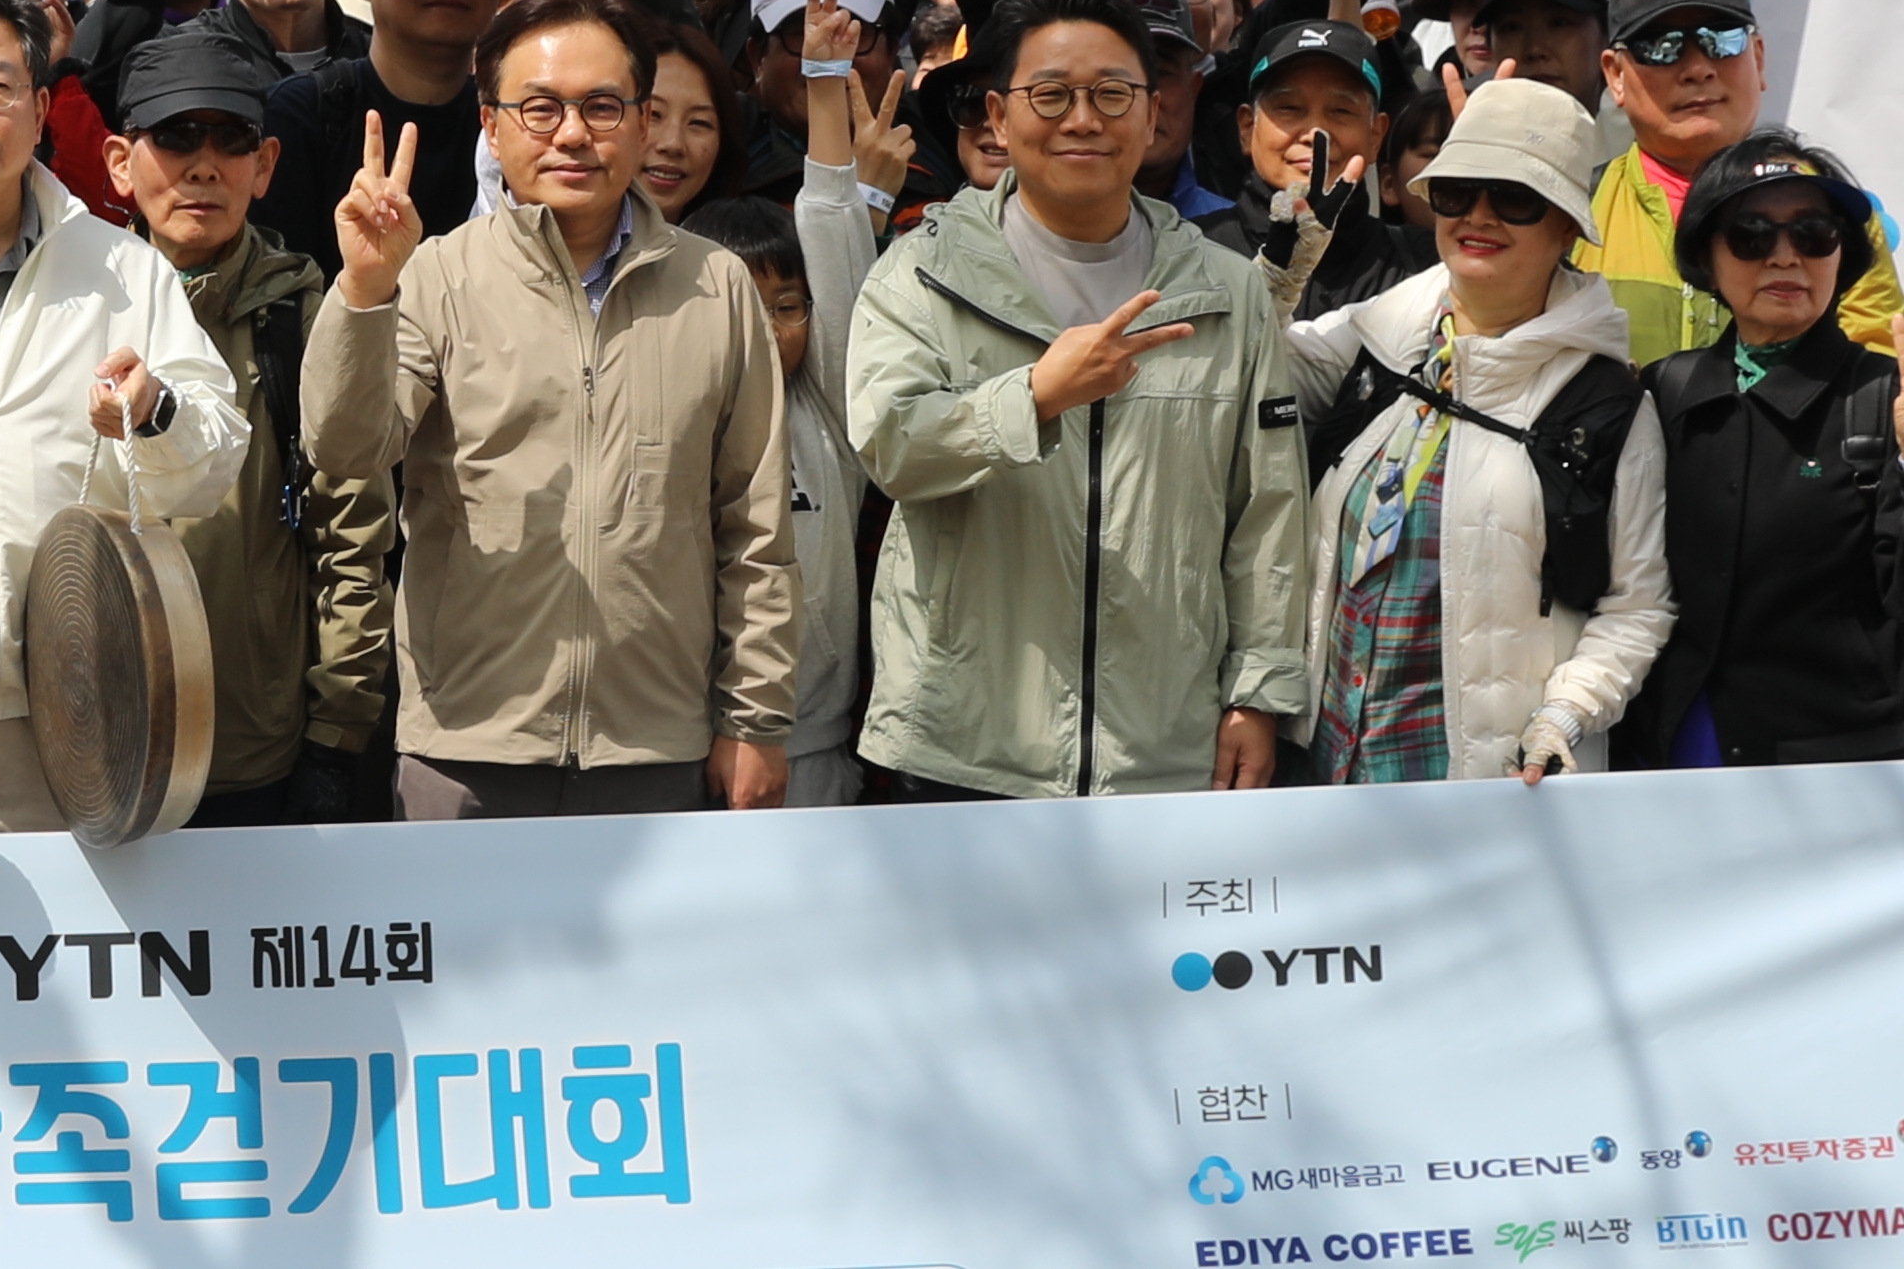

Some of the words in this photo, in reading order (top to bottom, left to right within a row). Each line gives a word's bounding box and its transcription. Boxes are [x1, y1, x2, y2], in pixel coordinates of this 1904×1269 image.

[1186, 878, 1253, 917] 주최
[250, 922, 434, 989] 제14회
[1262, 944, 1383, 987] YTN
[1198, 1084, 1268, 1123] 협찬
[1426, 1154, 1591, 1181] EUGENE
[1639, 1149, 1684, 1171] 동양
[1733, 1135, 1895, 1167] 유진투자증권
[1194, 1236, 1312, 1268] EDIYA
[1322, 1228, 1474, 1262] COFFEE
[1563, 1218, 1632, 1245] 씨스팡
